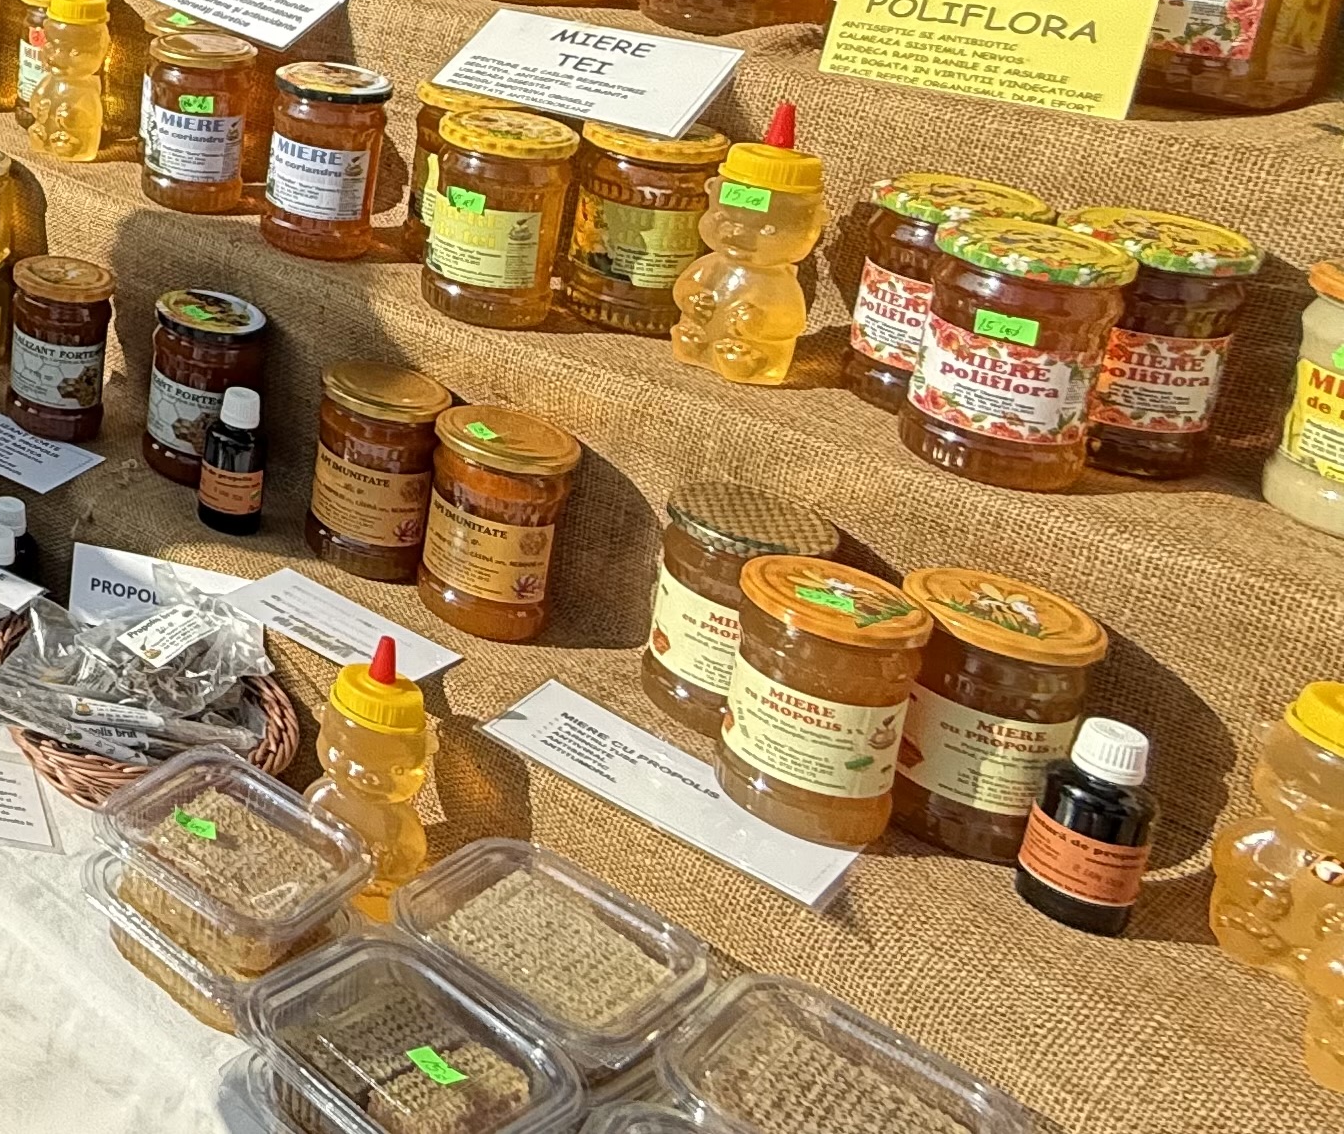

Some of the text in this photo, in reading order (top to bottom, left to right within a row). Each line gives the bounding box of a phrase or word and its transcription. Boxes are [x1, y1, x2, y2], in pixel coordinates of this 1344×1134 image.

[550, 28, 657, 58] MIERE
[838, 31, 1025, 65] CALMEAZA SISTEMUL NERVOS
[842, 20, 1018, 52] ANTISEPTIC SI ANTIBIOTIC
[558, 52, 615, 75] TEI
[831, 53, 1105, 102] MAI BOGATA IN VIRTUTII VINDECATOARE
[836, 42, 1071, 85] VINDECA RAPID RANILE SI ARSURILE
[830, 63, 1096, 113] REFACE REPEDE ORGANISMUL DUPA EFORT
[161, 114, 225, 133] MIERE
[171, 132, 225, 143] coriandru
[277, 137, 343, 166] MIERE
[284, 159, 342, 178] coriandru
[725, 188, 745, 200] 15
[860, 296, 926, 329] poliflo
[977, 317, 995, 332] 15
[59, 346, 97, 361] FORTE
[954, 350, 1052, 383] MIERE
[1108, 349, 1205, 372] MIERE
[175, 388, 218, 405] FORTE
[940, 361, 1060, 400] poliflora
[1306, 395, 1332, 415] de
[332, 462, 390, 488] IMUNITATE
[444, 505, 508, 540] IMUNITATE
[90, 576, 161, 606] PROPOL
[682, 613, 697, 625] cu
[745, 686, 842, 733] cu PROPOLIS
[769, 686, 836, 719] MIERE
[551, 730, 608, 764] ANTIVIRAL
[557, 726, 615, 760] LARINGITE
[563, 722, 639, 766] PENTRU TUSE
[939, 721, 1049, 754] cu PROPOLIS
[977, 720, 1047, 742] MIERE
[539, 739, 618, 784] ANTITUMORAL
[545, 735, 610, 771] ANTISEPTIC
[560, 711, 721, 800] MIERE CU PROPOLIS
[1070, 838, 1090, 851] de
